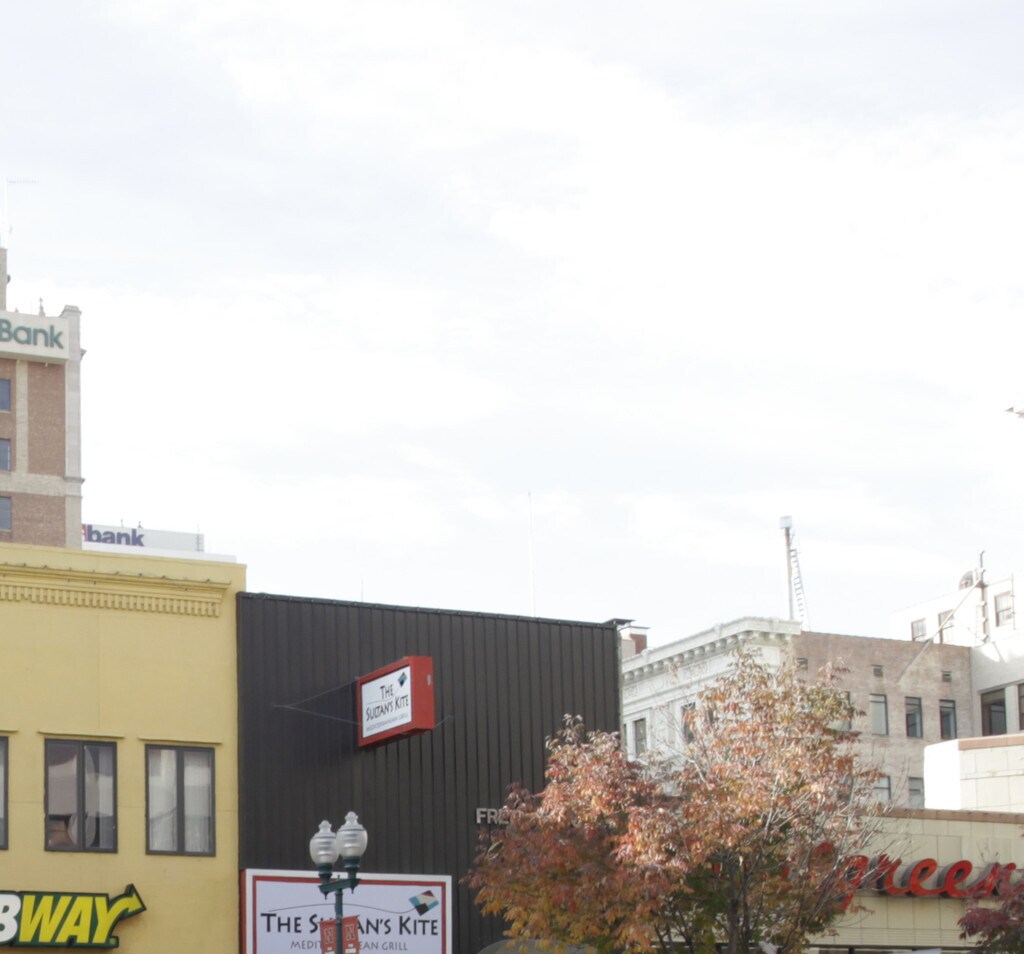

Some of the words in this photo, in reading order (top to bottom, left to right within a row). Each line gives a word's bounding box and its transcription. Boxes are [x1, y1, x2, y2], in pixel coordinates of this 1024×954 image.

[87, 524, 144, 547] bank
[380, 684, 394, 700] THE
[366, 701, 394, 721] SULTAN'S
[395, 694, 409, 711] KITE
[260, 912, 302, 934] THE
[309, 914, 392, 935] SAN'S
[399, 915, 439, 936] KITE
[381, 941, 408, 951] GRILL
